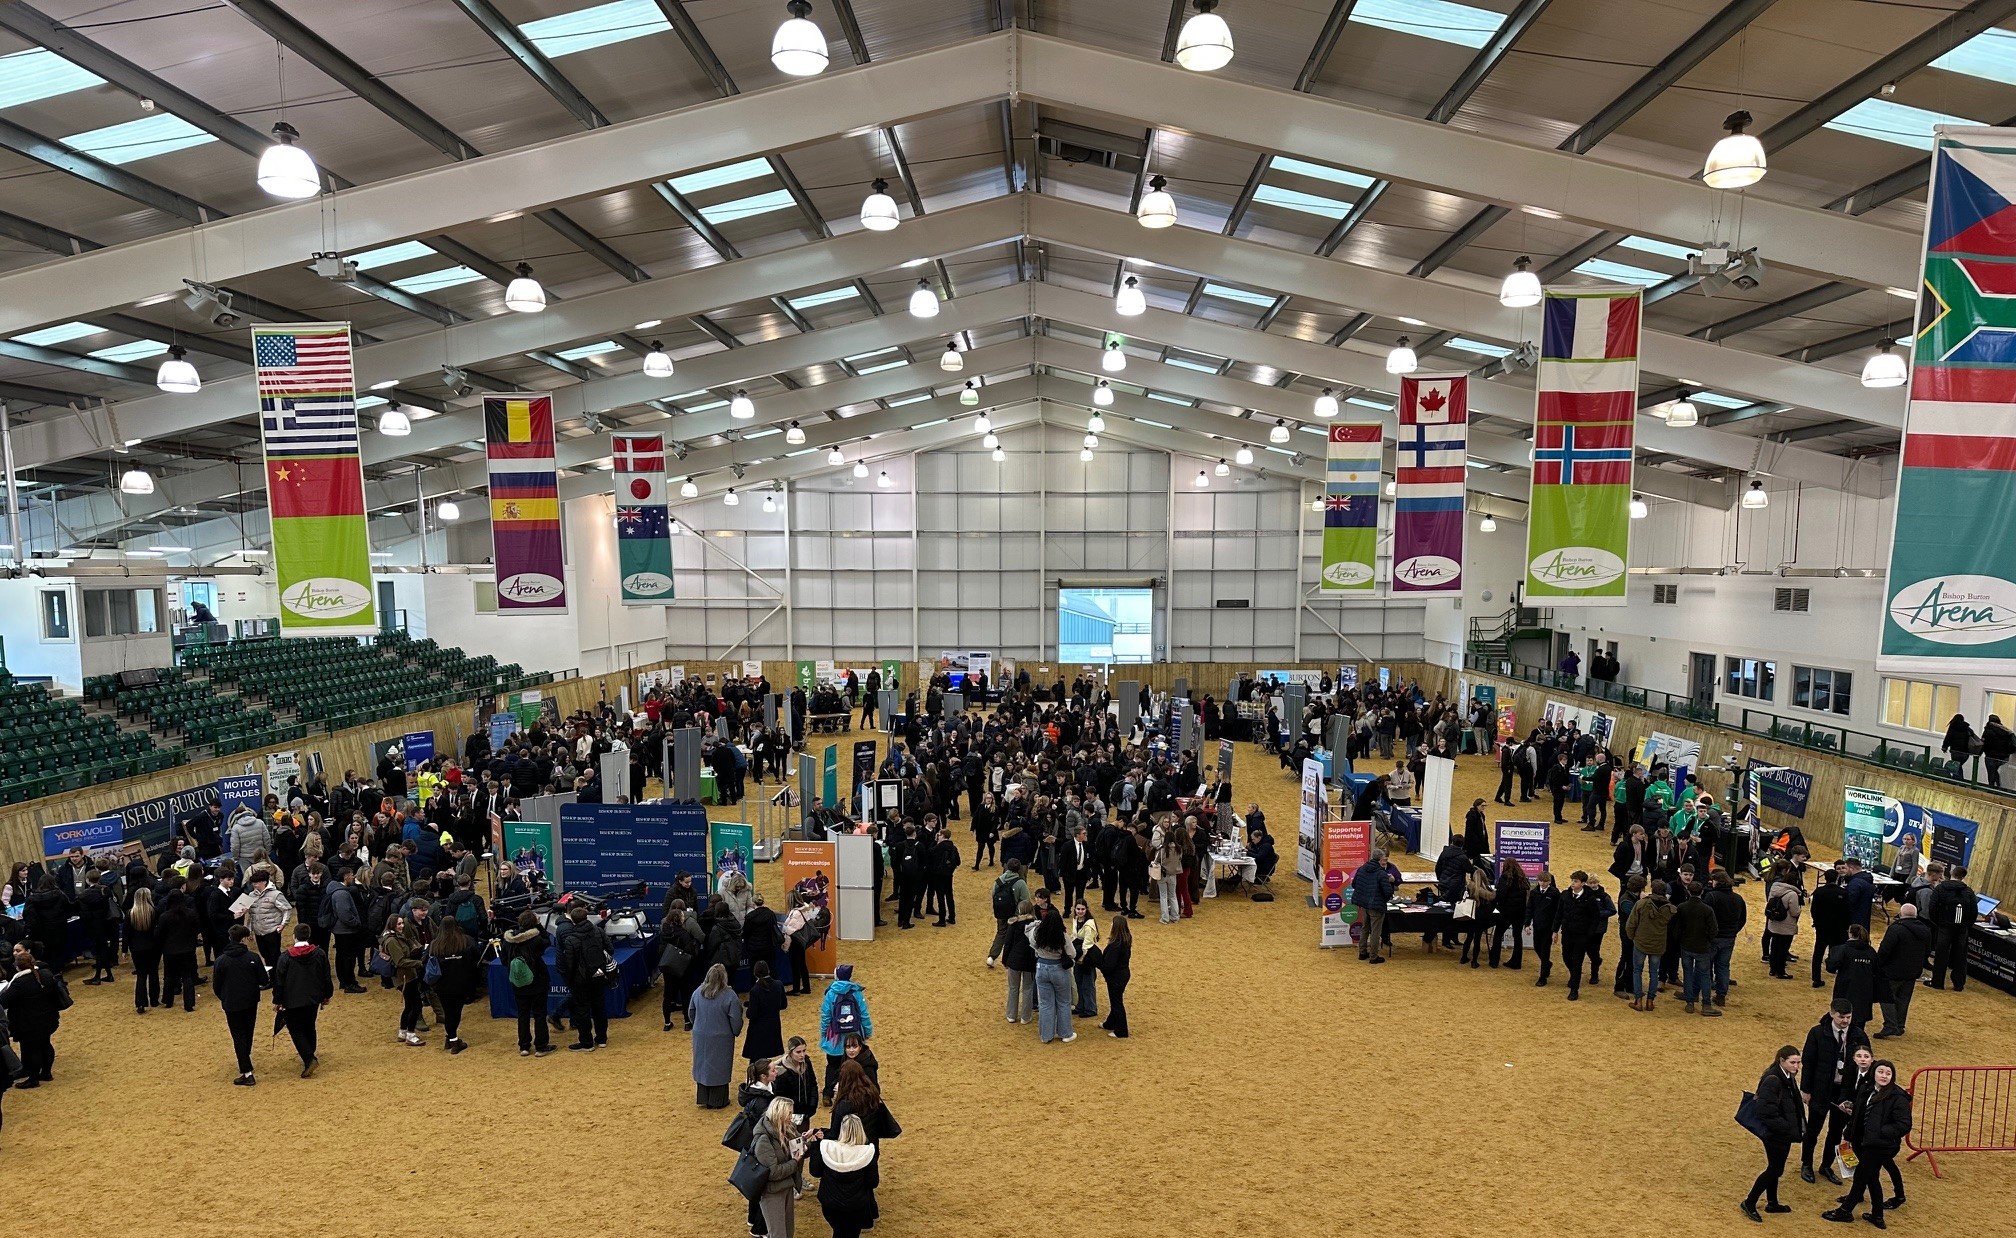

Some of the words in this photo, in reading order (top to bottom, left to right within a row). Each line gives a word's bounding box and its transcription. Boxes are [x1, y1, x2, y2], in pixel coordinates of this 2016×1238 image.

[1330, 564, 1359, 579] Arena
[1404, 559, 1442, 578] Arena
[1543, 551, 1596, 579] Arena
[508, 577, 544, 596] Arena
[630, 575, 658, 590] Arena
[295, 582, 345, 609] Arena
[1911, 581, 1995, 627] Arena
[224, 779, 258, 790] MOTOR
[1776, 770, 1810, 790] BURTON
[223, 789, 260, 800] TRADES
[1786, 787, 1806, 801] College
[1848, 791, 1883, 802] WORKLINK
[1854, 802, 1875, 810] TRAINING
[112, 800, 166, 830] ISHOP
[55, 826, 113, 840] YORKWOLD
